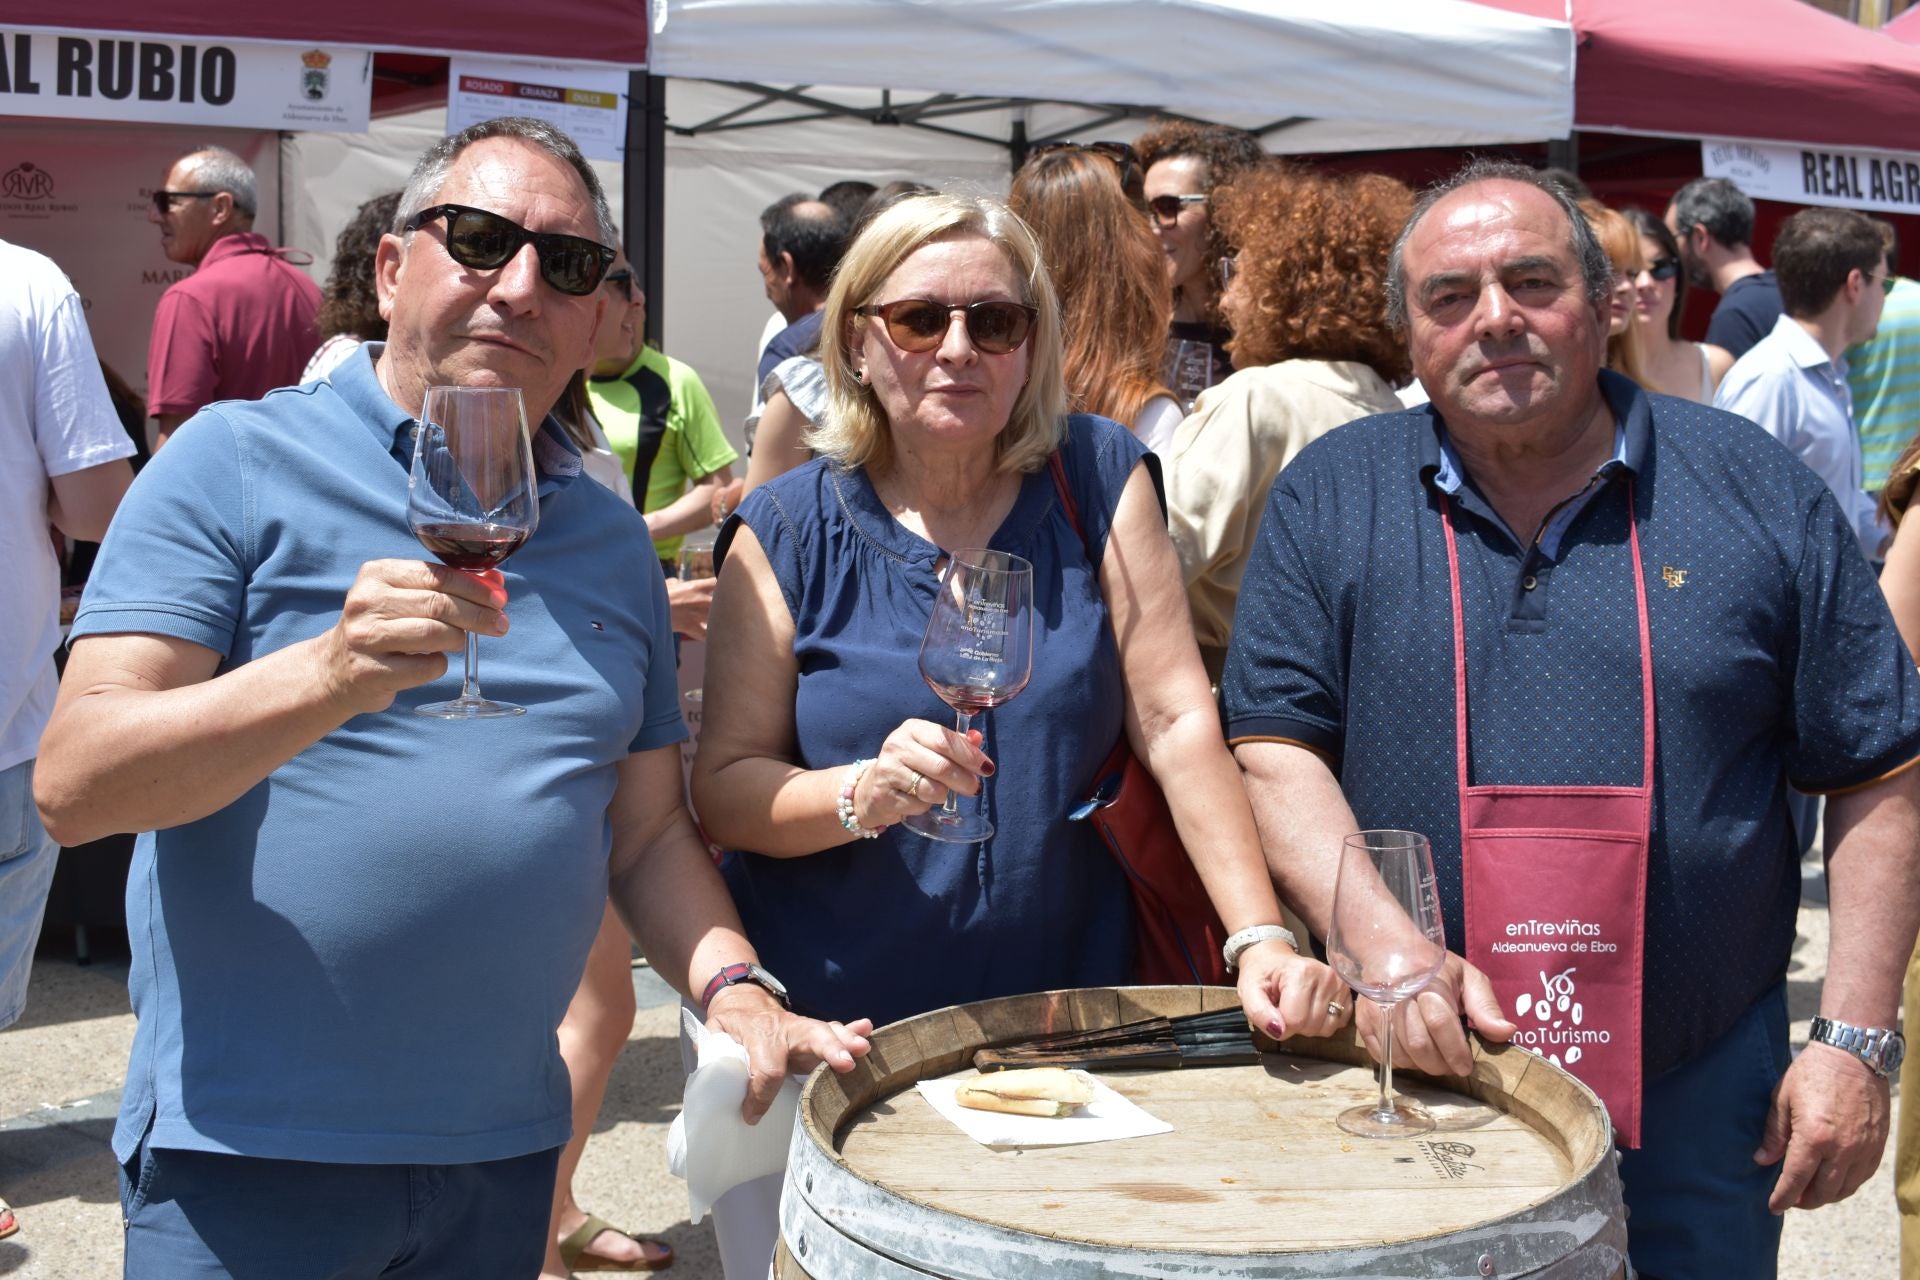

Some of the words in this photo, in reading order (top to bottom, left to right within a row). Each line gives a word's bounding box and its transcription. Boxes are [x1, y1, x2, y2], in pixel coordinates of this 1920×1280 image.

[57, 36, 236, 106] RUBIO
[465, 79, 504, 93] ROSADO
[520, 87, 559, 99] CRIANZA
[572, 93, 600, 104] DULCE
[1801, 151, 1863, 200] REAL
[1506, 920, 1601, 936] enTreviñas
[1491, 942, 1567, 953] Aldeanueva
[1570, 941, 1588, 952] de
[1591, 941, 1617, 953] Ebro
[1508, 1027, 1611, 1044] noTurismo
